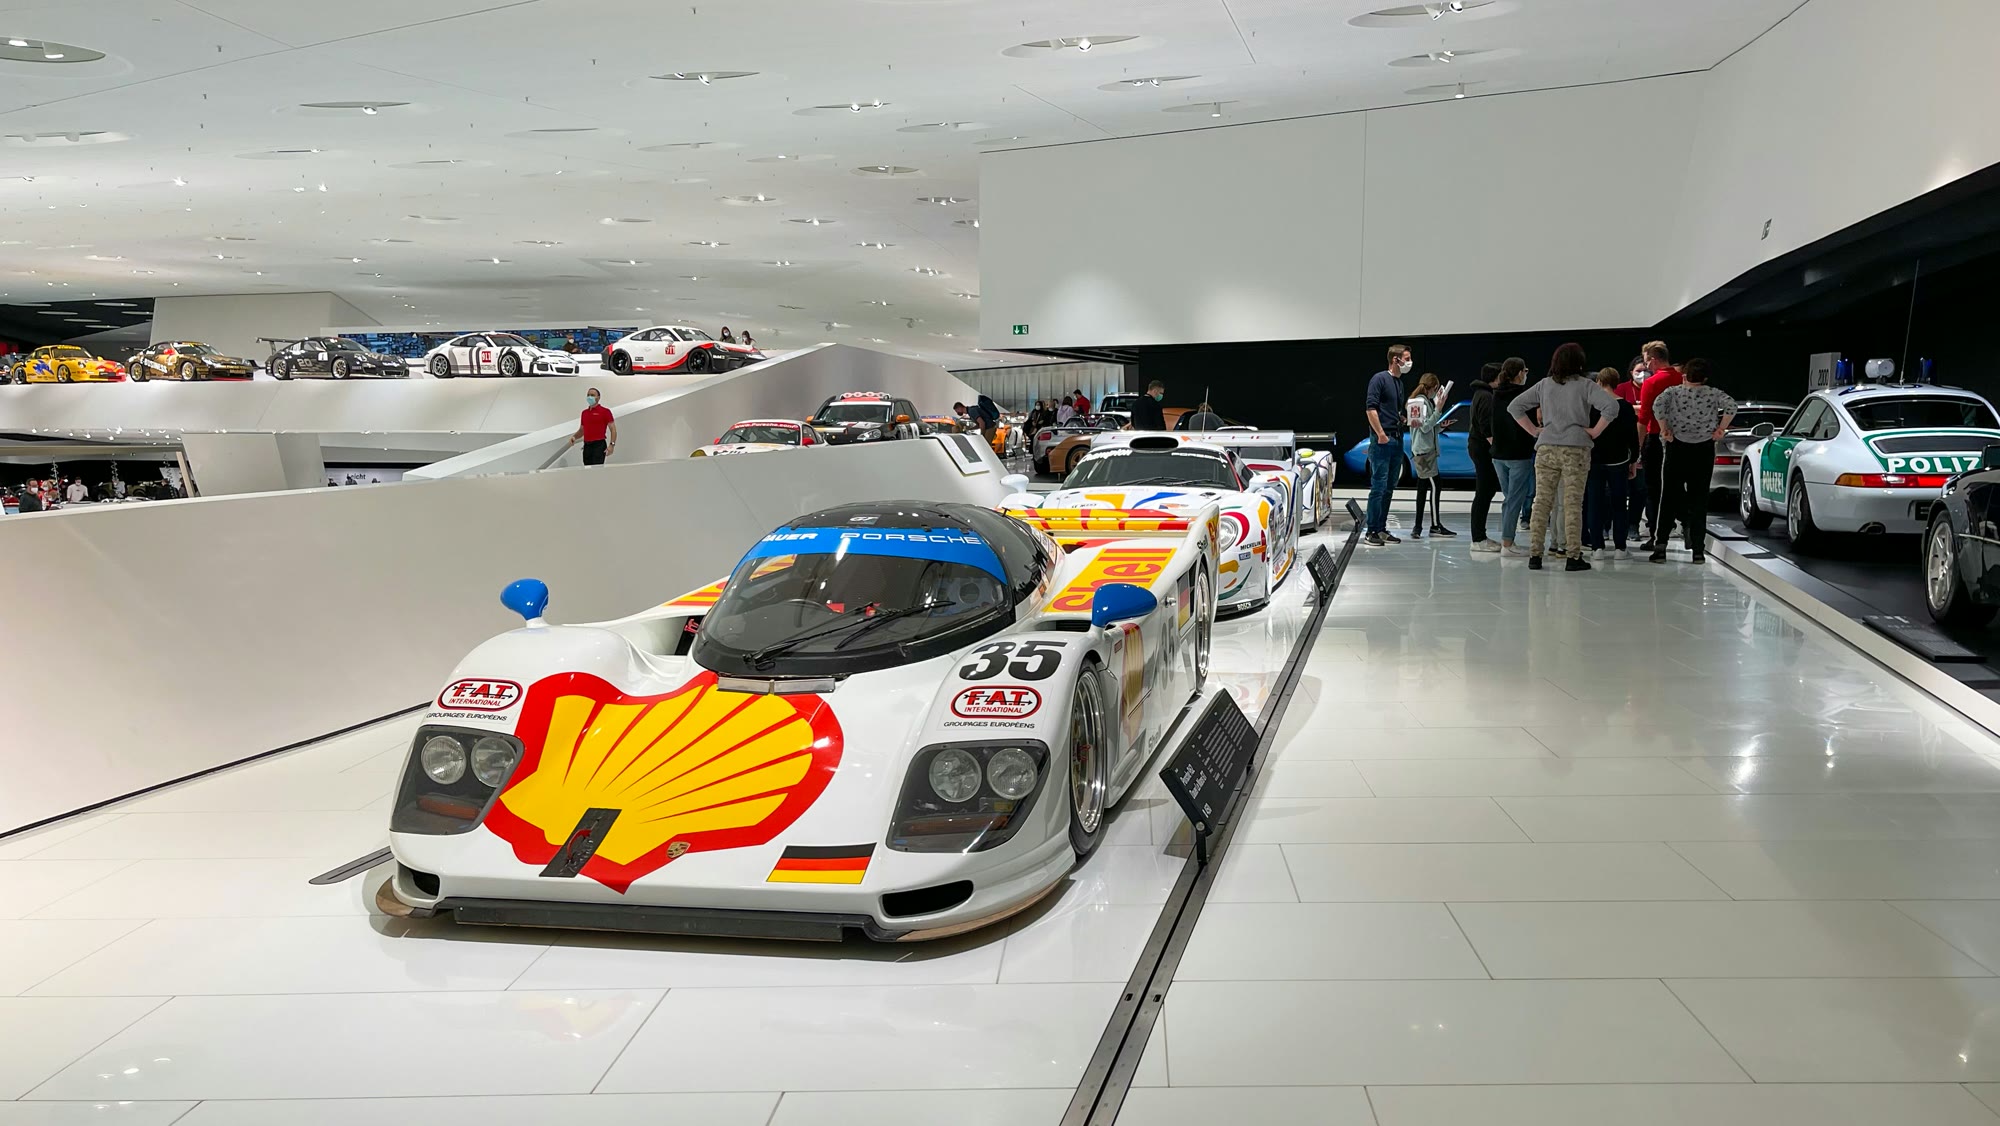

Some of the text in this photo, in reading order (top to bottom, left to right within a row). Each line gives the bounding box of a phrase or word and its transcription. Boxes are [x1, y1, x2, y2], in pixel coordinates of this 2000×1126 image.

[1762, 470, 1784, 494] POLIZEI
[840, 532, 982, 545] PORSCHE
[1240, 540, 1262, 550] MICHELIN
[1237, 601, 1251, 611] BOSCH
[959, 641, 1068, 681] 35
[453, 683, 513, 699] F.A.T.
[448, 698, 502, 706] INTERNATIONAL
[966, 691, 1029, 706] F.A.T.
[466, 712, 507, 721] EUROPÉENS
[990, 721, 1035, 729] EUROPÉENS
